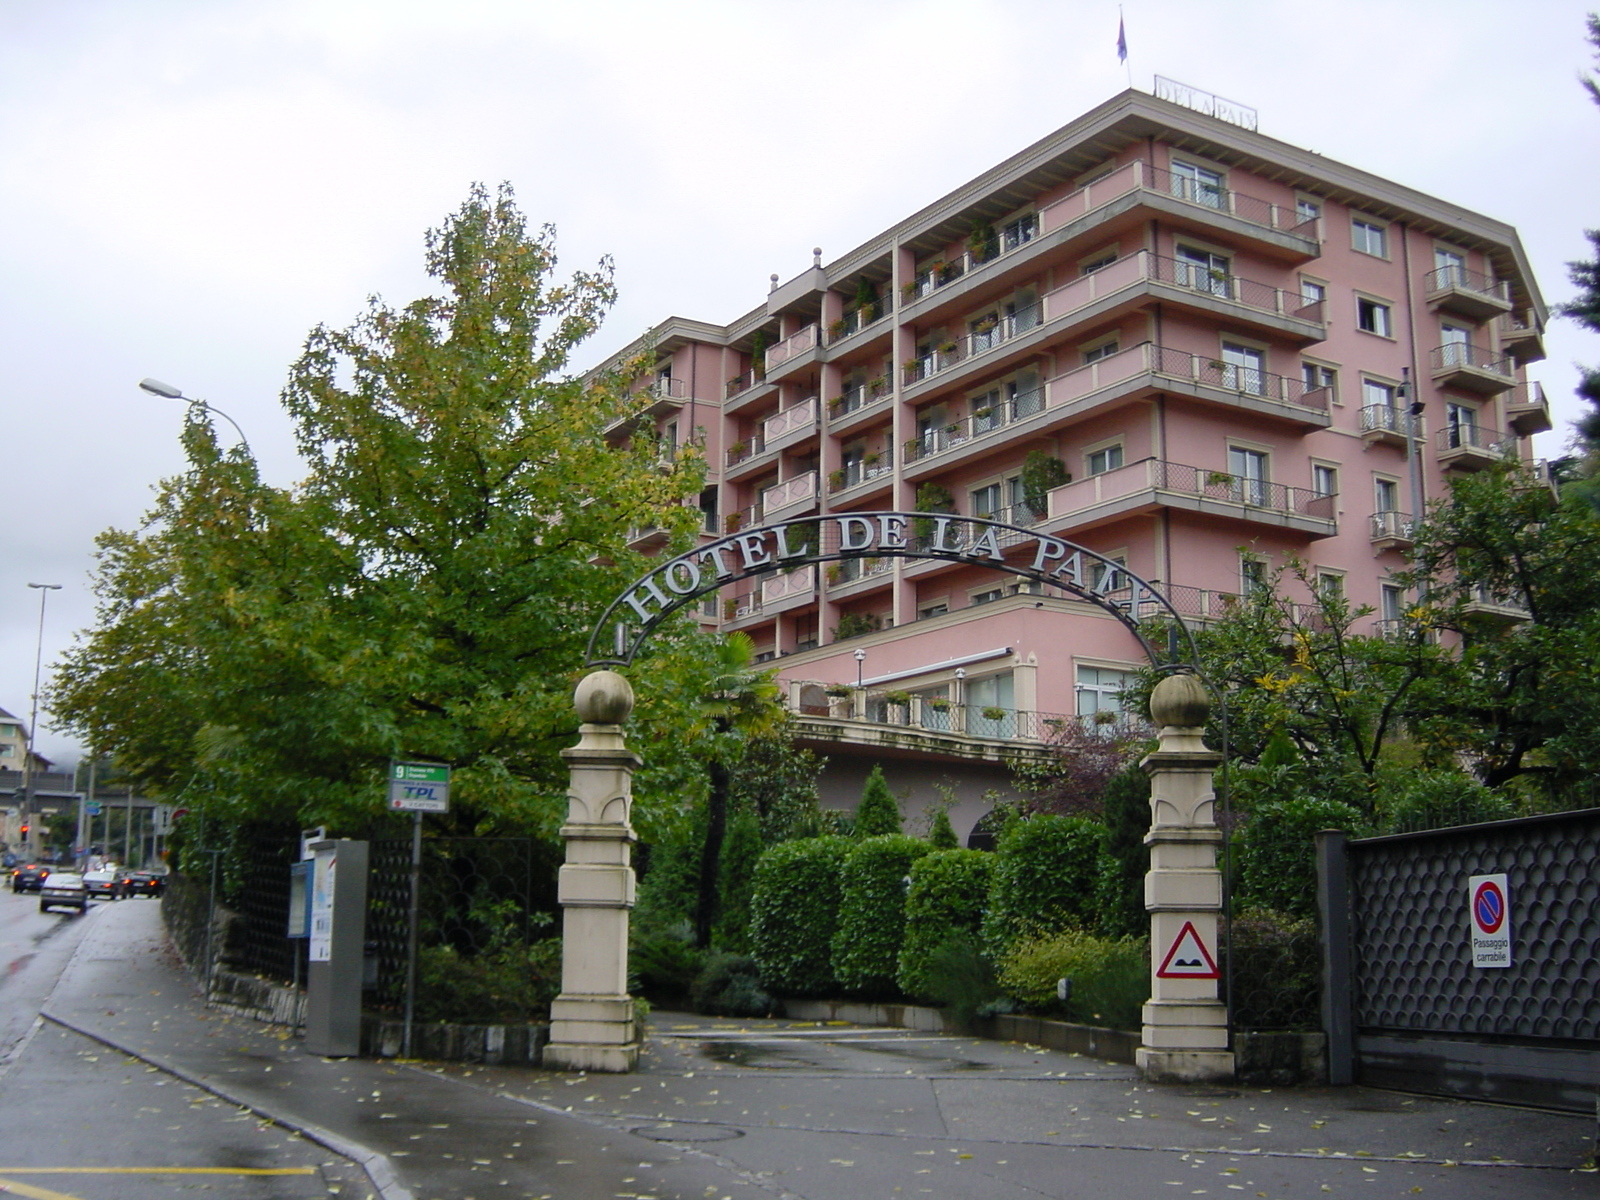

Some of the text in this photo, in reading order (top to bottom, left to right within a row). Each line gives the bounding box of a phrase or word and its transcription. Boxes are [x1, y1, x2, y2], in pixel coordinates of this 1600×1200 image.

[623, 514, 1160, 626] HOTEL DE LA PAIX
[395, 765, 404, 778] 9
[404, 786, 438, 801] TPL
[1473, 938, 1508, 950] Passaggio
[1476, 951, 1507, 962] carrabile
